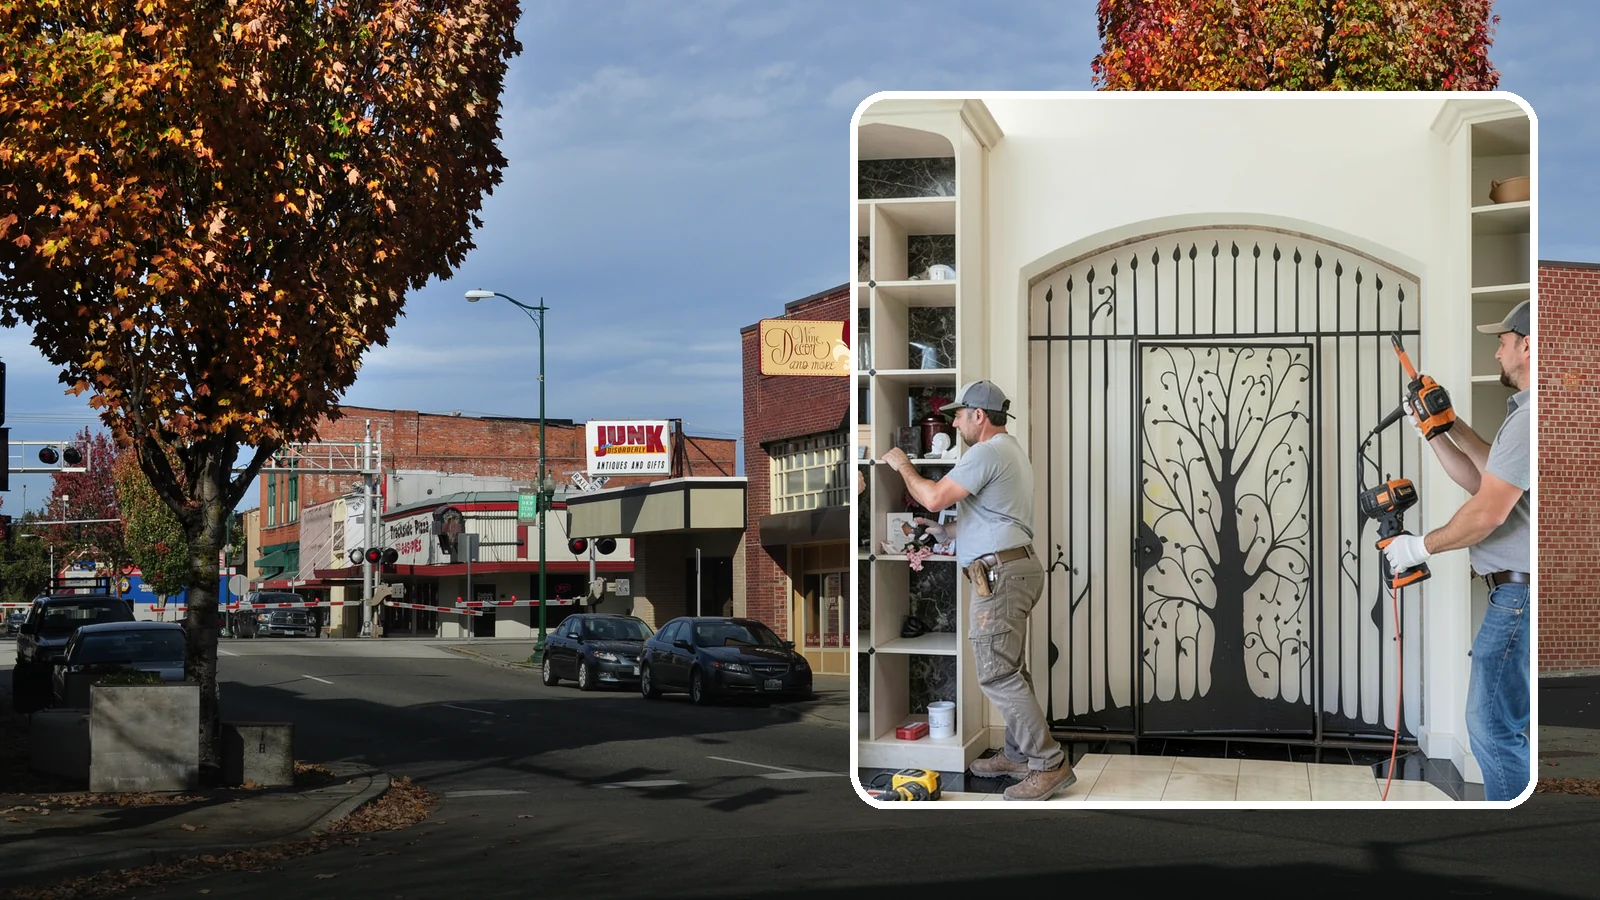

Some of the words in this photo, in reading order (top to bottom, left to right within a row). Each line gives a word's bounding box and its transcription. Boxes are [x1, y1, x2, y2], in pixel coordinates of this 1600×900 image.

[595, 425, 665, 457] JUNK
[607, 446, 645, 454] DISORDERLY
[597, 461, 628, 470] ANTIQUES
[631, 461, 644, 470] AND
[647, 460, 665, 469] GIFTS
[414, 519, 429, 535] Pizza
